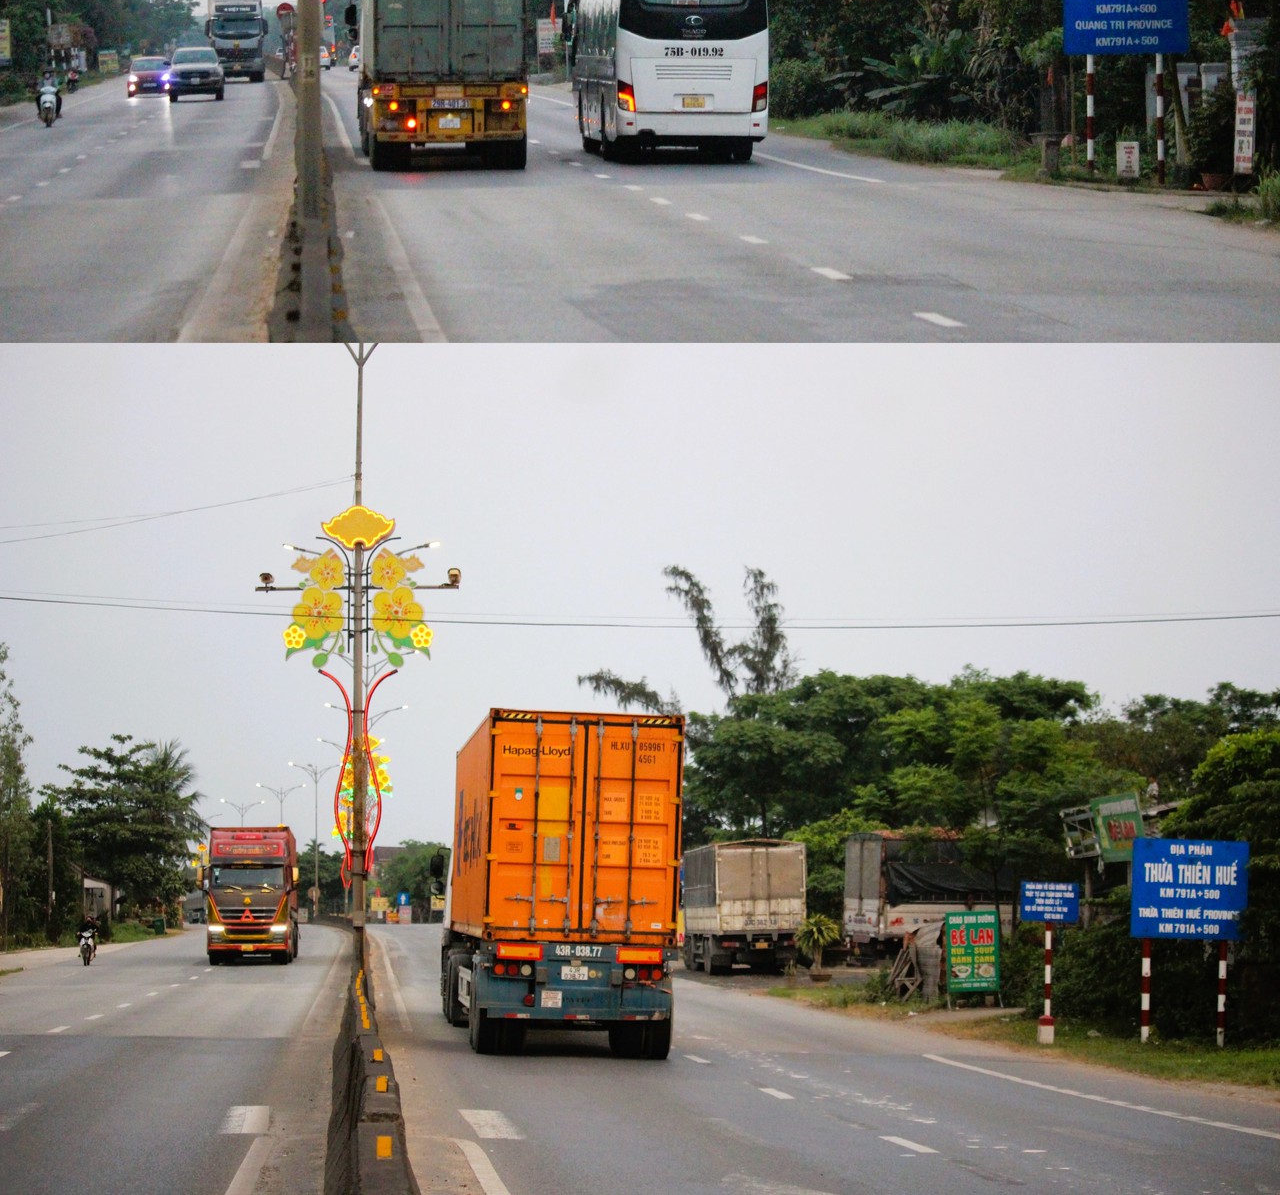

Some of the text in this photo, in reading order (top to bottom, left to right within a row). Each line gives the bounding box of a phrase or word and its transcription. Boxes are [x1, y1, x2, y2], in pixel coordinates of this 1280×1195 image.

[1096, 4, 1157, 14] KM791A+500
[1075, 19, 1172, 30] QUANG TRI PROVINCE
[503, 745, 570, 758] Hapag-Lloyd
[611, 741, 677, 752] HLXU 859961 7
[638, 755, 656, 764] 45G1
[1170, 843, 1213, 857] ĐỊA PHẬN
[1178, 861, 1211, 884] THIÊN
[1216, 860, 1238, 885] HUẾ
[1160, 888, 1174, 898] KM
[1161, 907, 1183, 919] THIÊN
[1186, 907, 1201, 919] HUẾ
[1159, 923, 1173, 933] KM
[950, 925, 994, 946] BÉ LAN
